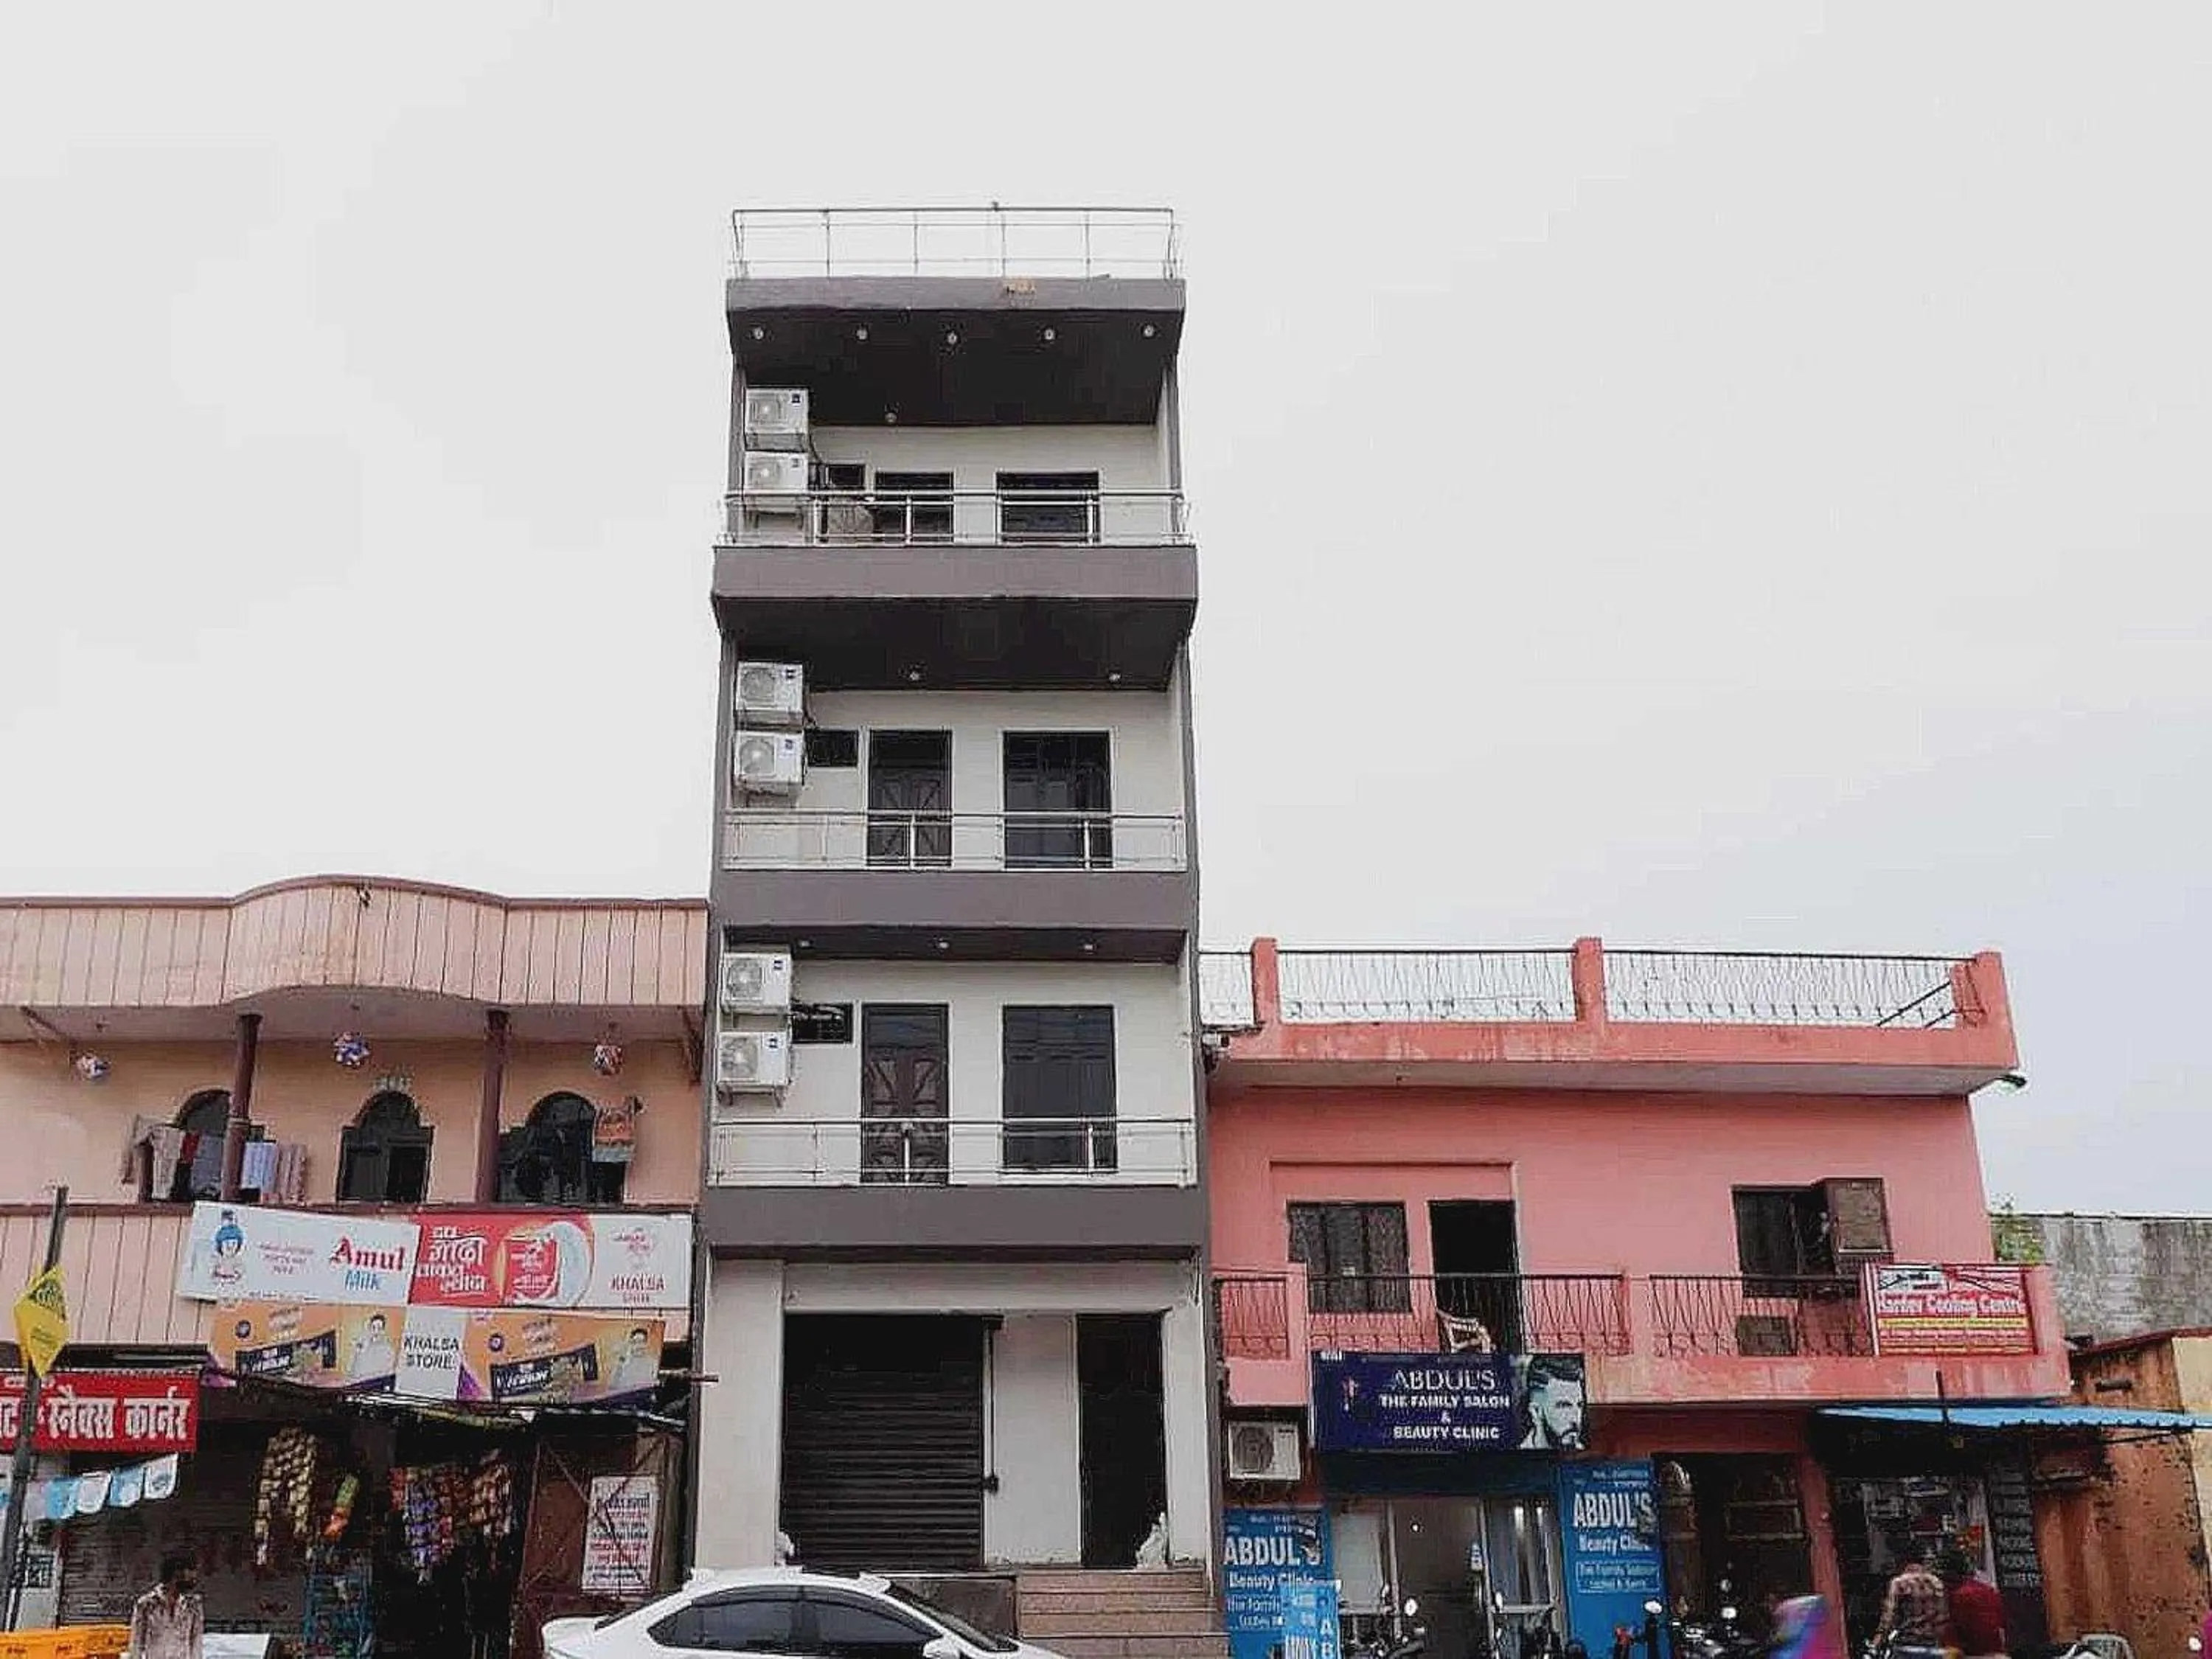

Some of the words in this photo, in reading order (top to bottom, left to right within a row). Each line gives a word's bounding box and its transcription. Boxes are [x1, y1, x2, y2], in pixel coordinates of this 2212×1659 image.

[330, 1237, 404, 1272] Amul
[1411, 1394, 1459, 1409] FAMILY
[1463, 1394, 1510, 1409] SALON
[1393, 1425, 1450, 1439] BEAUTY
[1453, 1425, 1500, 1439] CLINIC
